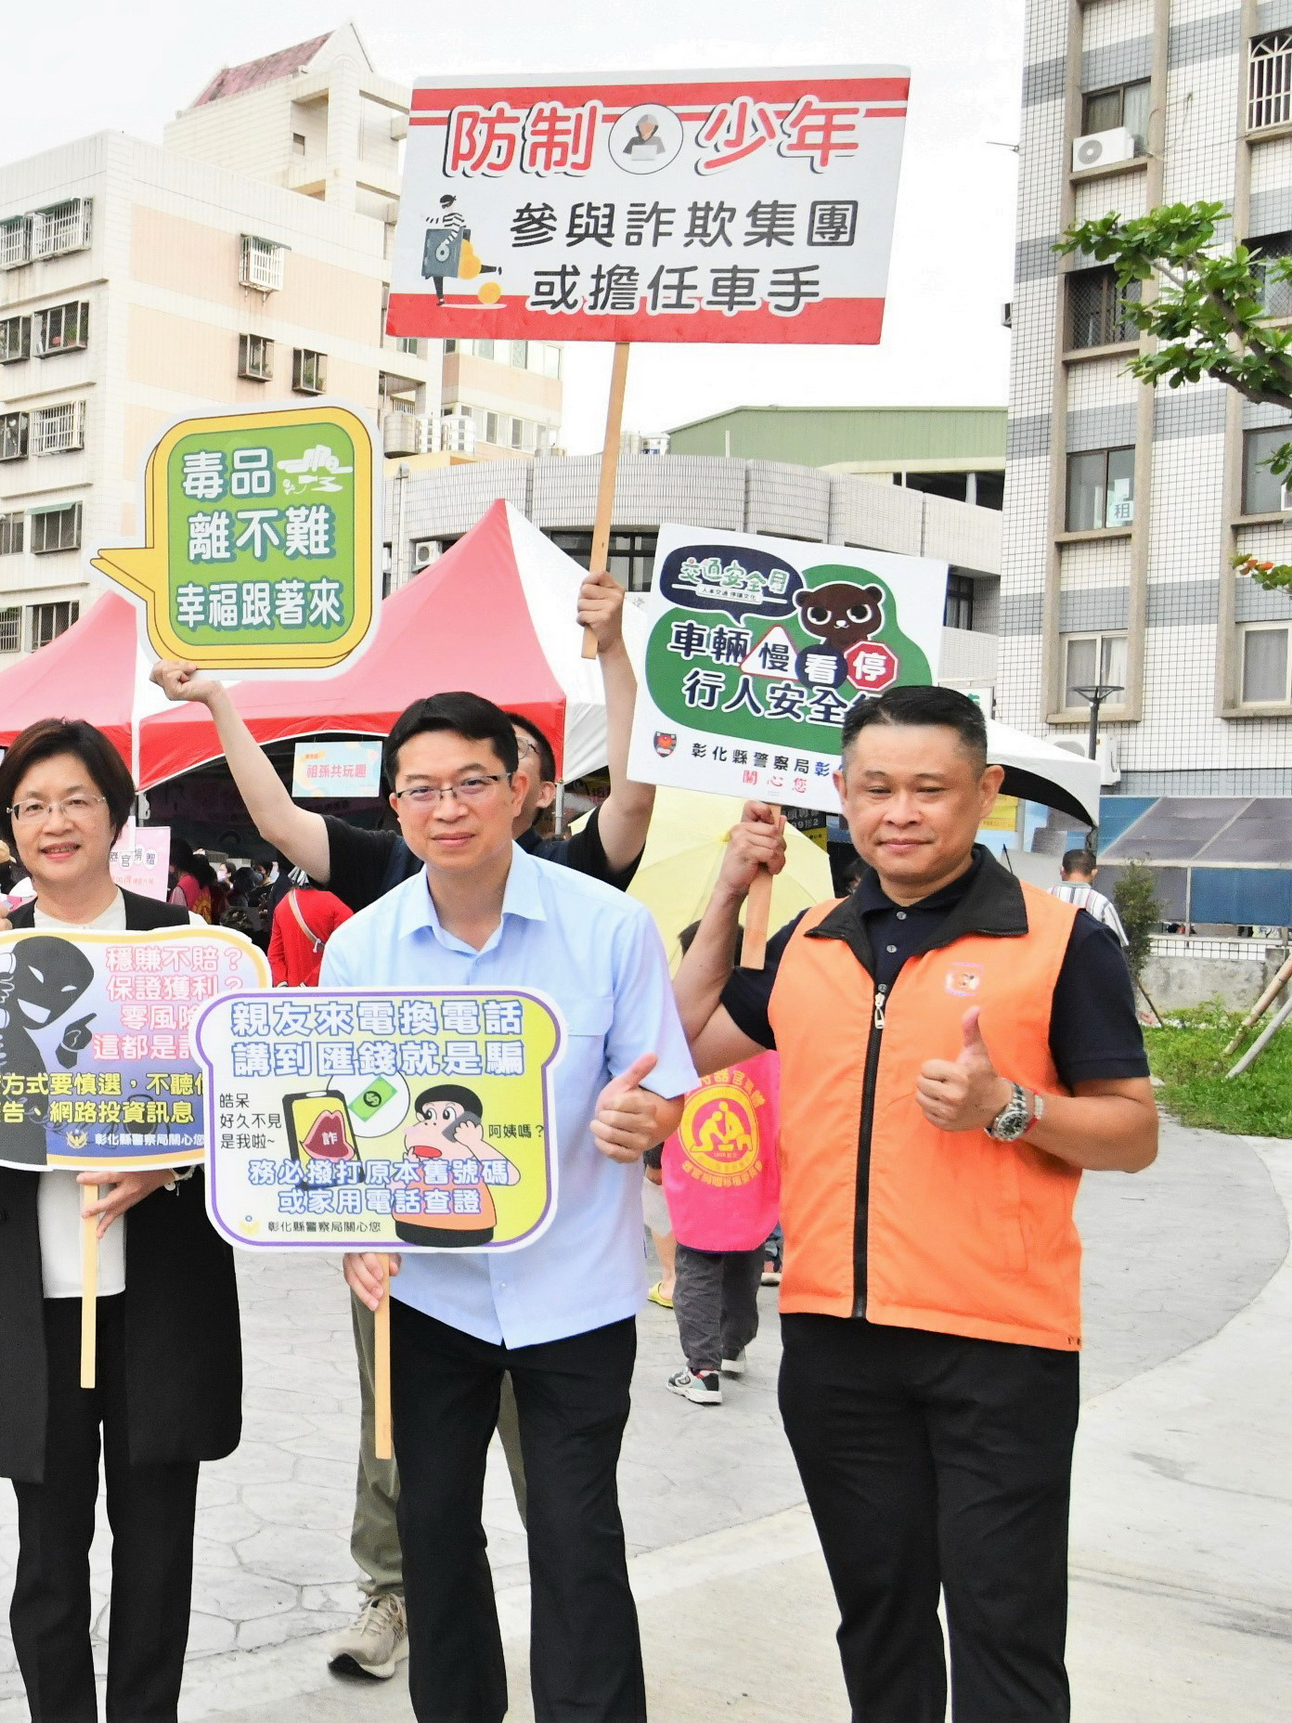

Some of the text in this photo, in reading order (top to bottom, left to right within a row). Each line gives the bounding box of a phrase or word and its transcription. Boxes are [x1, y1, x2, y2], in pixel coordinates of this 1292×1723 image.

[447, 97, 860, 174] 防制 少年
[510, 199, 859, 249] 參與詐欺集團
[530, 263, 820, 313] 或擔任車手
[182, 448, 272, 499] 毒品
[188, 505, 330, 561] 離不難
[678, 557, 789, 594] 交通安全月
[176, 578, 341, 628] 幸福跟著來
[691, 743, 844, 778] 彰化縣警察局彰
[230, 1000, 524, 1037] 親友來電換電話
[232, 1040, 525, 1077] 講到匯錢就是騙
[219, 1092, 250, 1110] 皓呆
[219, 1113, 282, 1129] 好久不見
[321, 1130, 338, 1146] 詐
[488, 1123, 544, 1140] 阿姨嗎？
[248, 1158, 509, 1186] 務必撥打原本舊號碼
[278, 1188, 482, 1215] 或家用電話查證
[267, 1220, 382, 1234] 彰化縣警察局關心您
